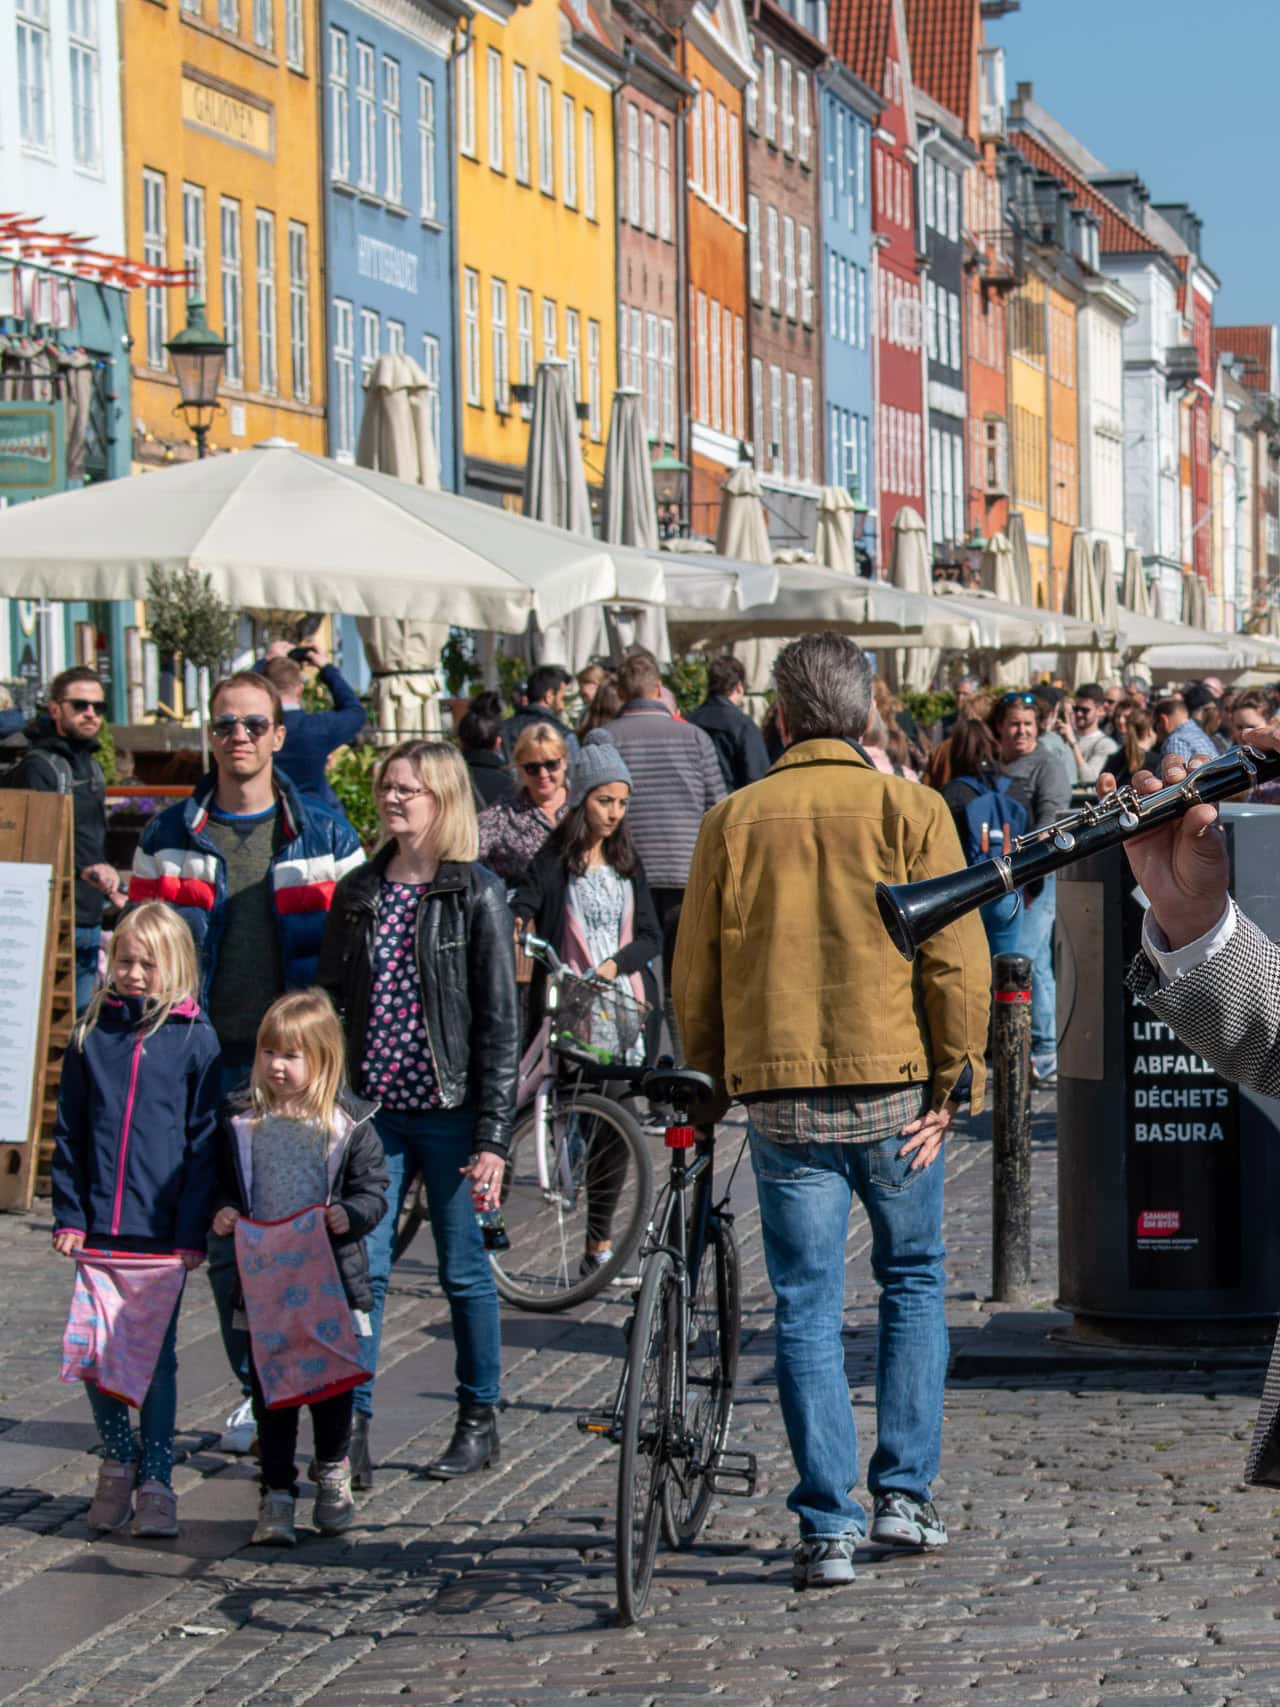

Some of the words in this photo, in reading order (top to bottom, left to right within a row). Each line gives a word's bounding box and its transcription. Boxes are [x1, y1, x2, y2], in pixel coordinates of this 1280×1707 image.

[1133, 1022, 1175, 1040] LITT
[1134, 1055, 1215, 1074] ABFALL
[1134, 1085, 1229, 1108] DÉCHETS
[1135, 1122, 1224, 1142] BASURA
[1143, 1211, 1179, 1220] SAMMEN
[1157, 1220, 1179, 1229] BYEN
